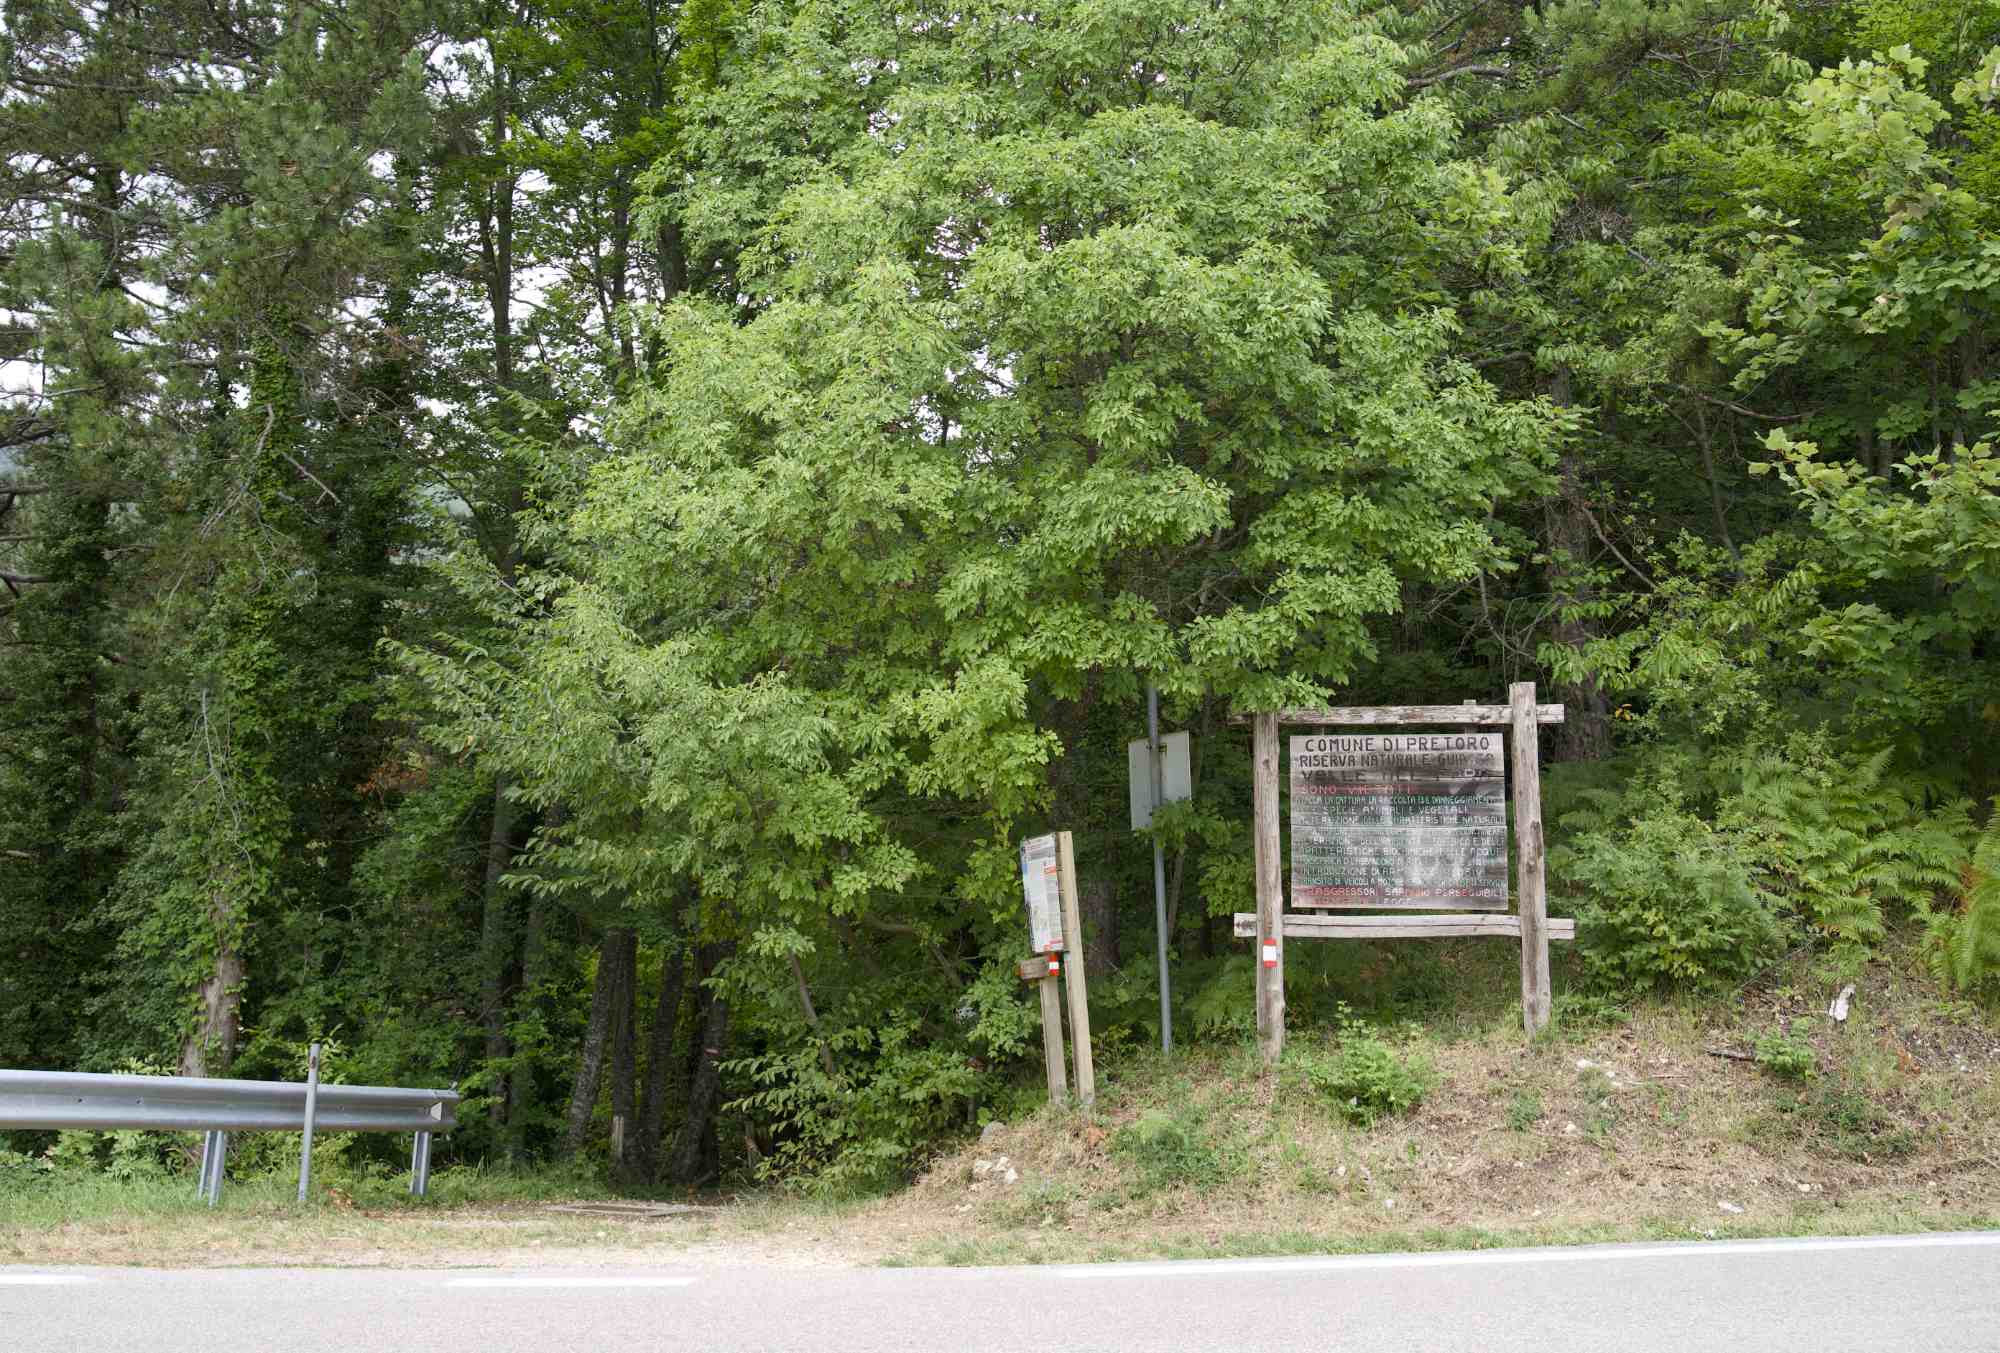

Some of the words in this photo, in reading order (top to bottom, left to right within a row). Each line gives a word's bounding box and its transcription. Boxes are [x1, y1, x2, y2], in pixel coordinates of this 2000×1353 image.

[1305, 738, 1376, 752] COMUNE
[1383, 737, 1399, 751] DI
[1407, 737, 1490, 751] PRETORO
[1299, 755, 1356, 768] RISERVA
[1361, 754, 1432, 768] NATURALE
[1302, 770, 1367, 782] VALLE
[1302, 785, 1337, 794] SONO
